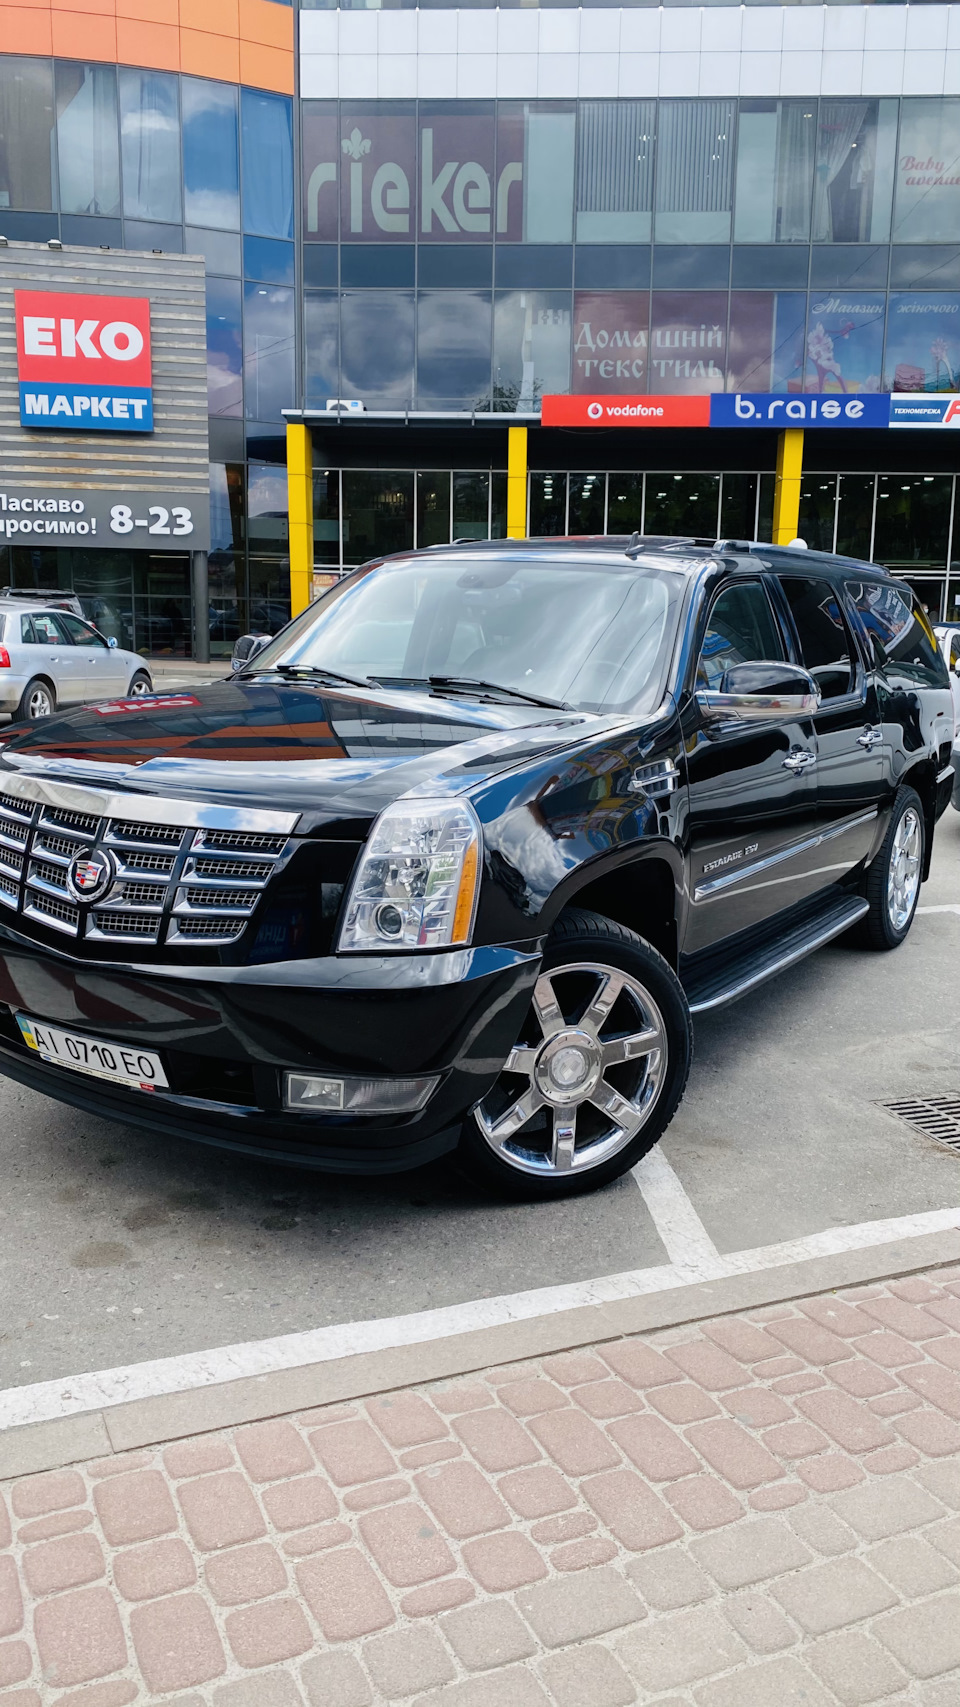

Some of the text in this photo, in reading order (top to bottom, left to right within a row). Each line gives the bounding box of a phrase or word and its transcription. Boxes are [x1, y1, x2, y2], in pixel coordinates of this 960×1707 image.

[900, 155, 945, 174] Baby
[307, 127, 523, 233] rieker
[811, 297, 959, 314] Магазин жіночого
[23, 316, 144, 361] ЕКО
[24, 393, 148, 420] МАРКЕТ
[606, 404, 664, 417] vodafone
[894, 407, 942, 415] ТЕХНОМЕРЕЖА
[109, 503, 194, 536] 8-23
[26, 1036, 36, 1046] UA
[33, 1026, 59, 1054] AI
[64, 1037, 117, 1071] 0710
[119, 1051, 155, 1079] EO
